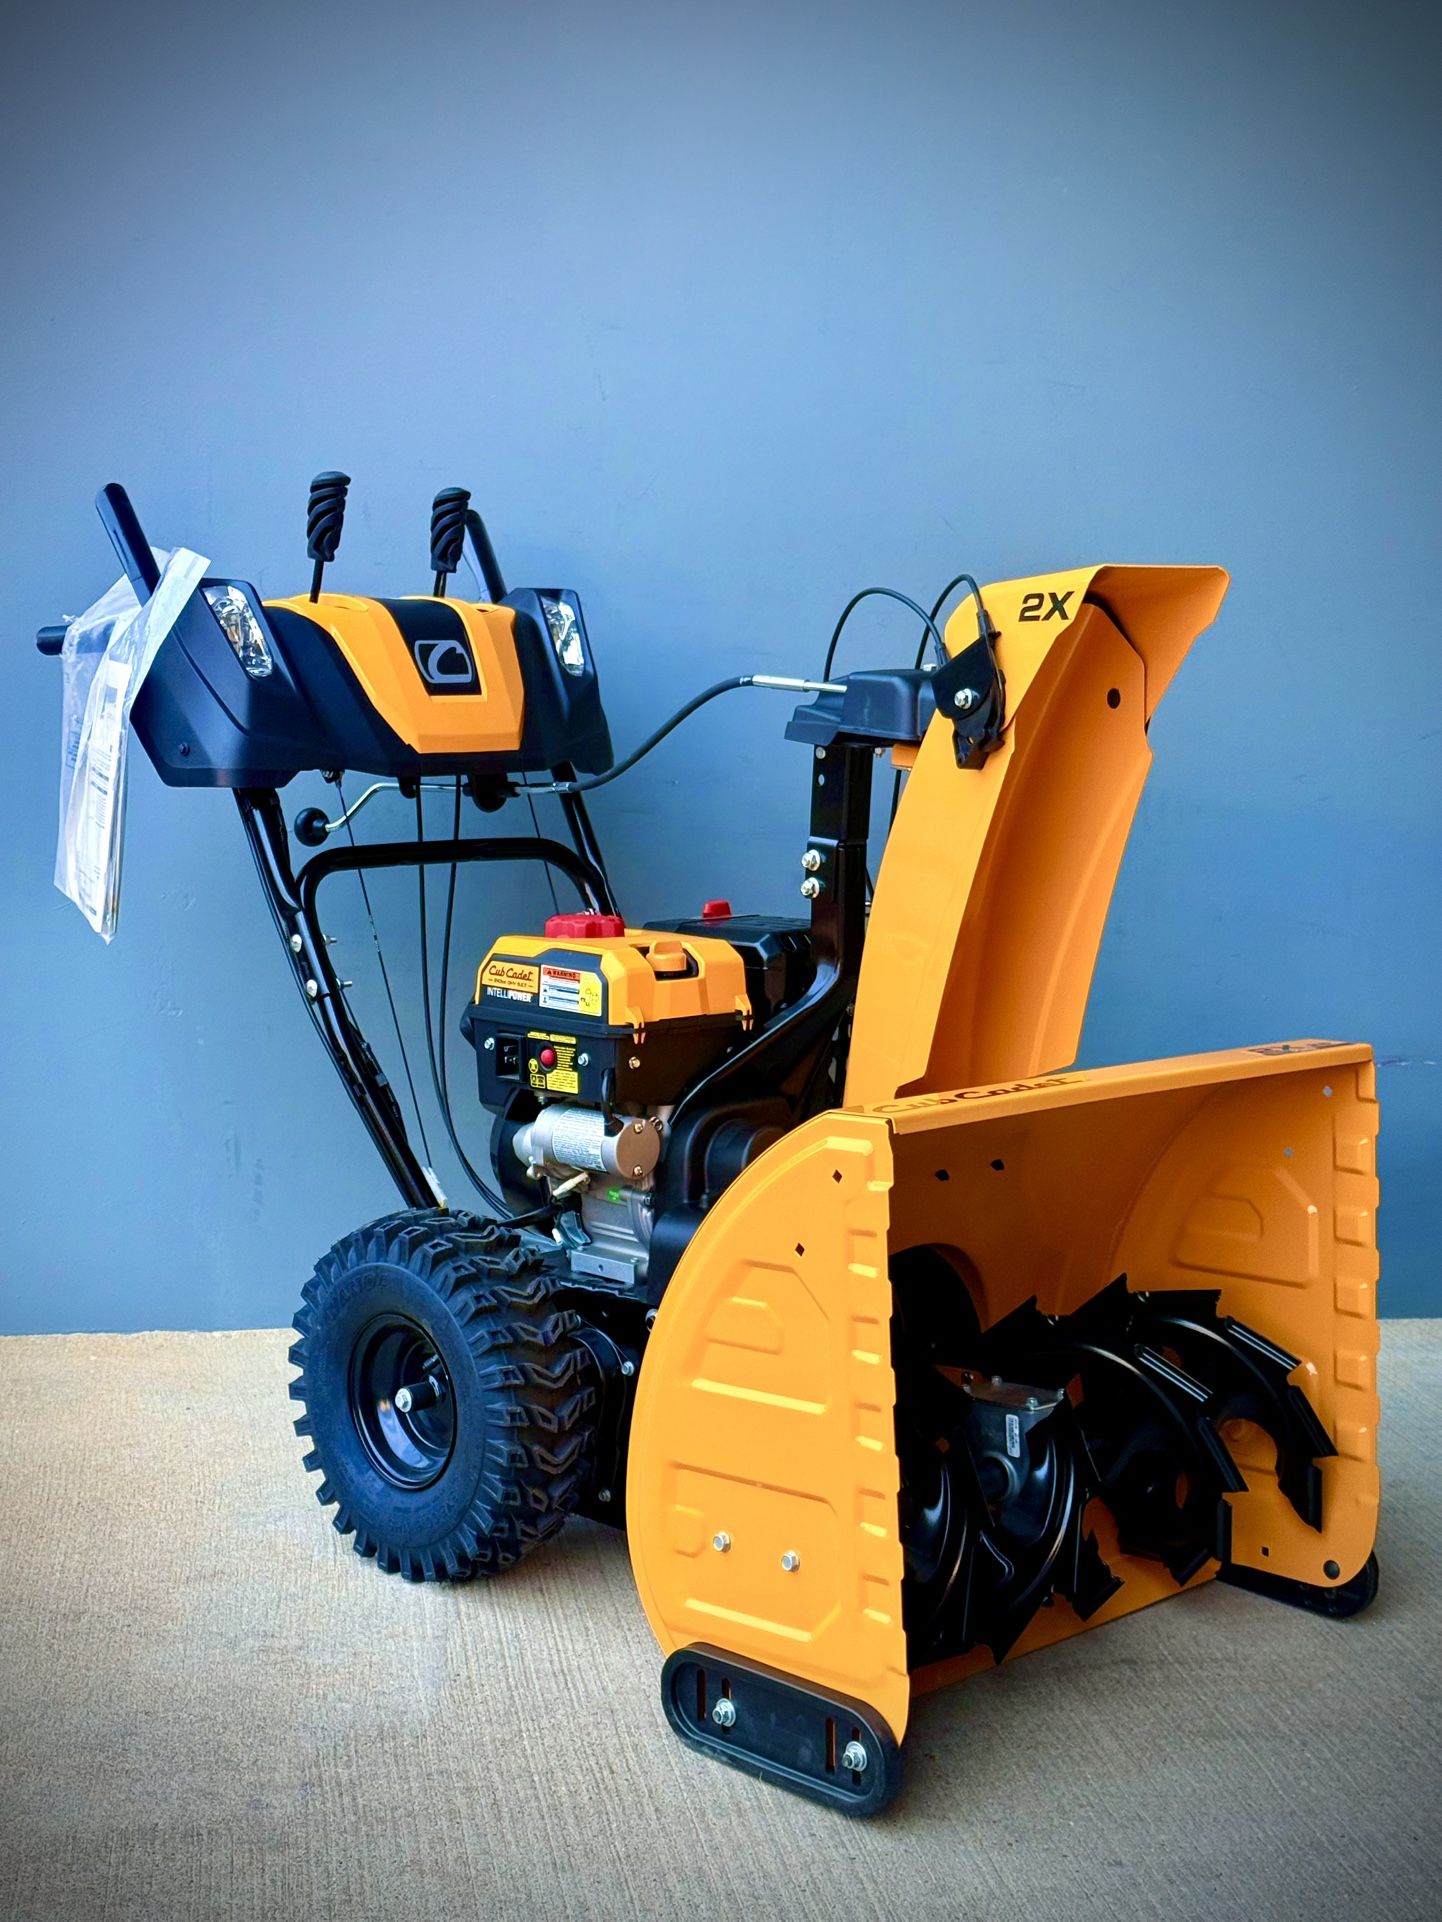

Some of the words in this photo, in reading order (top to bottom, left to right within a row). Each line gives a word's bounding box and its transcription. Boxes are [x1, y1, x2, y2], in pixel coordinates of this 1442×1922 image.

[1018, 590, 1075, 622] 2X
[488, 965, 505, 976] Cub
[505, 967, 535, 982] Cadet
[486, 986, 532, 1003] INTELLIPOWER
[872, 1094, 957, 1114] Cub
[953, 1076, 1084, 1100] Cadet
